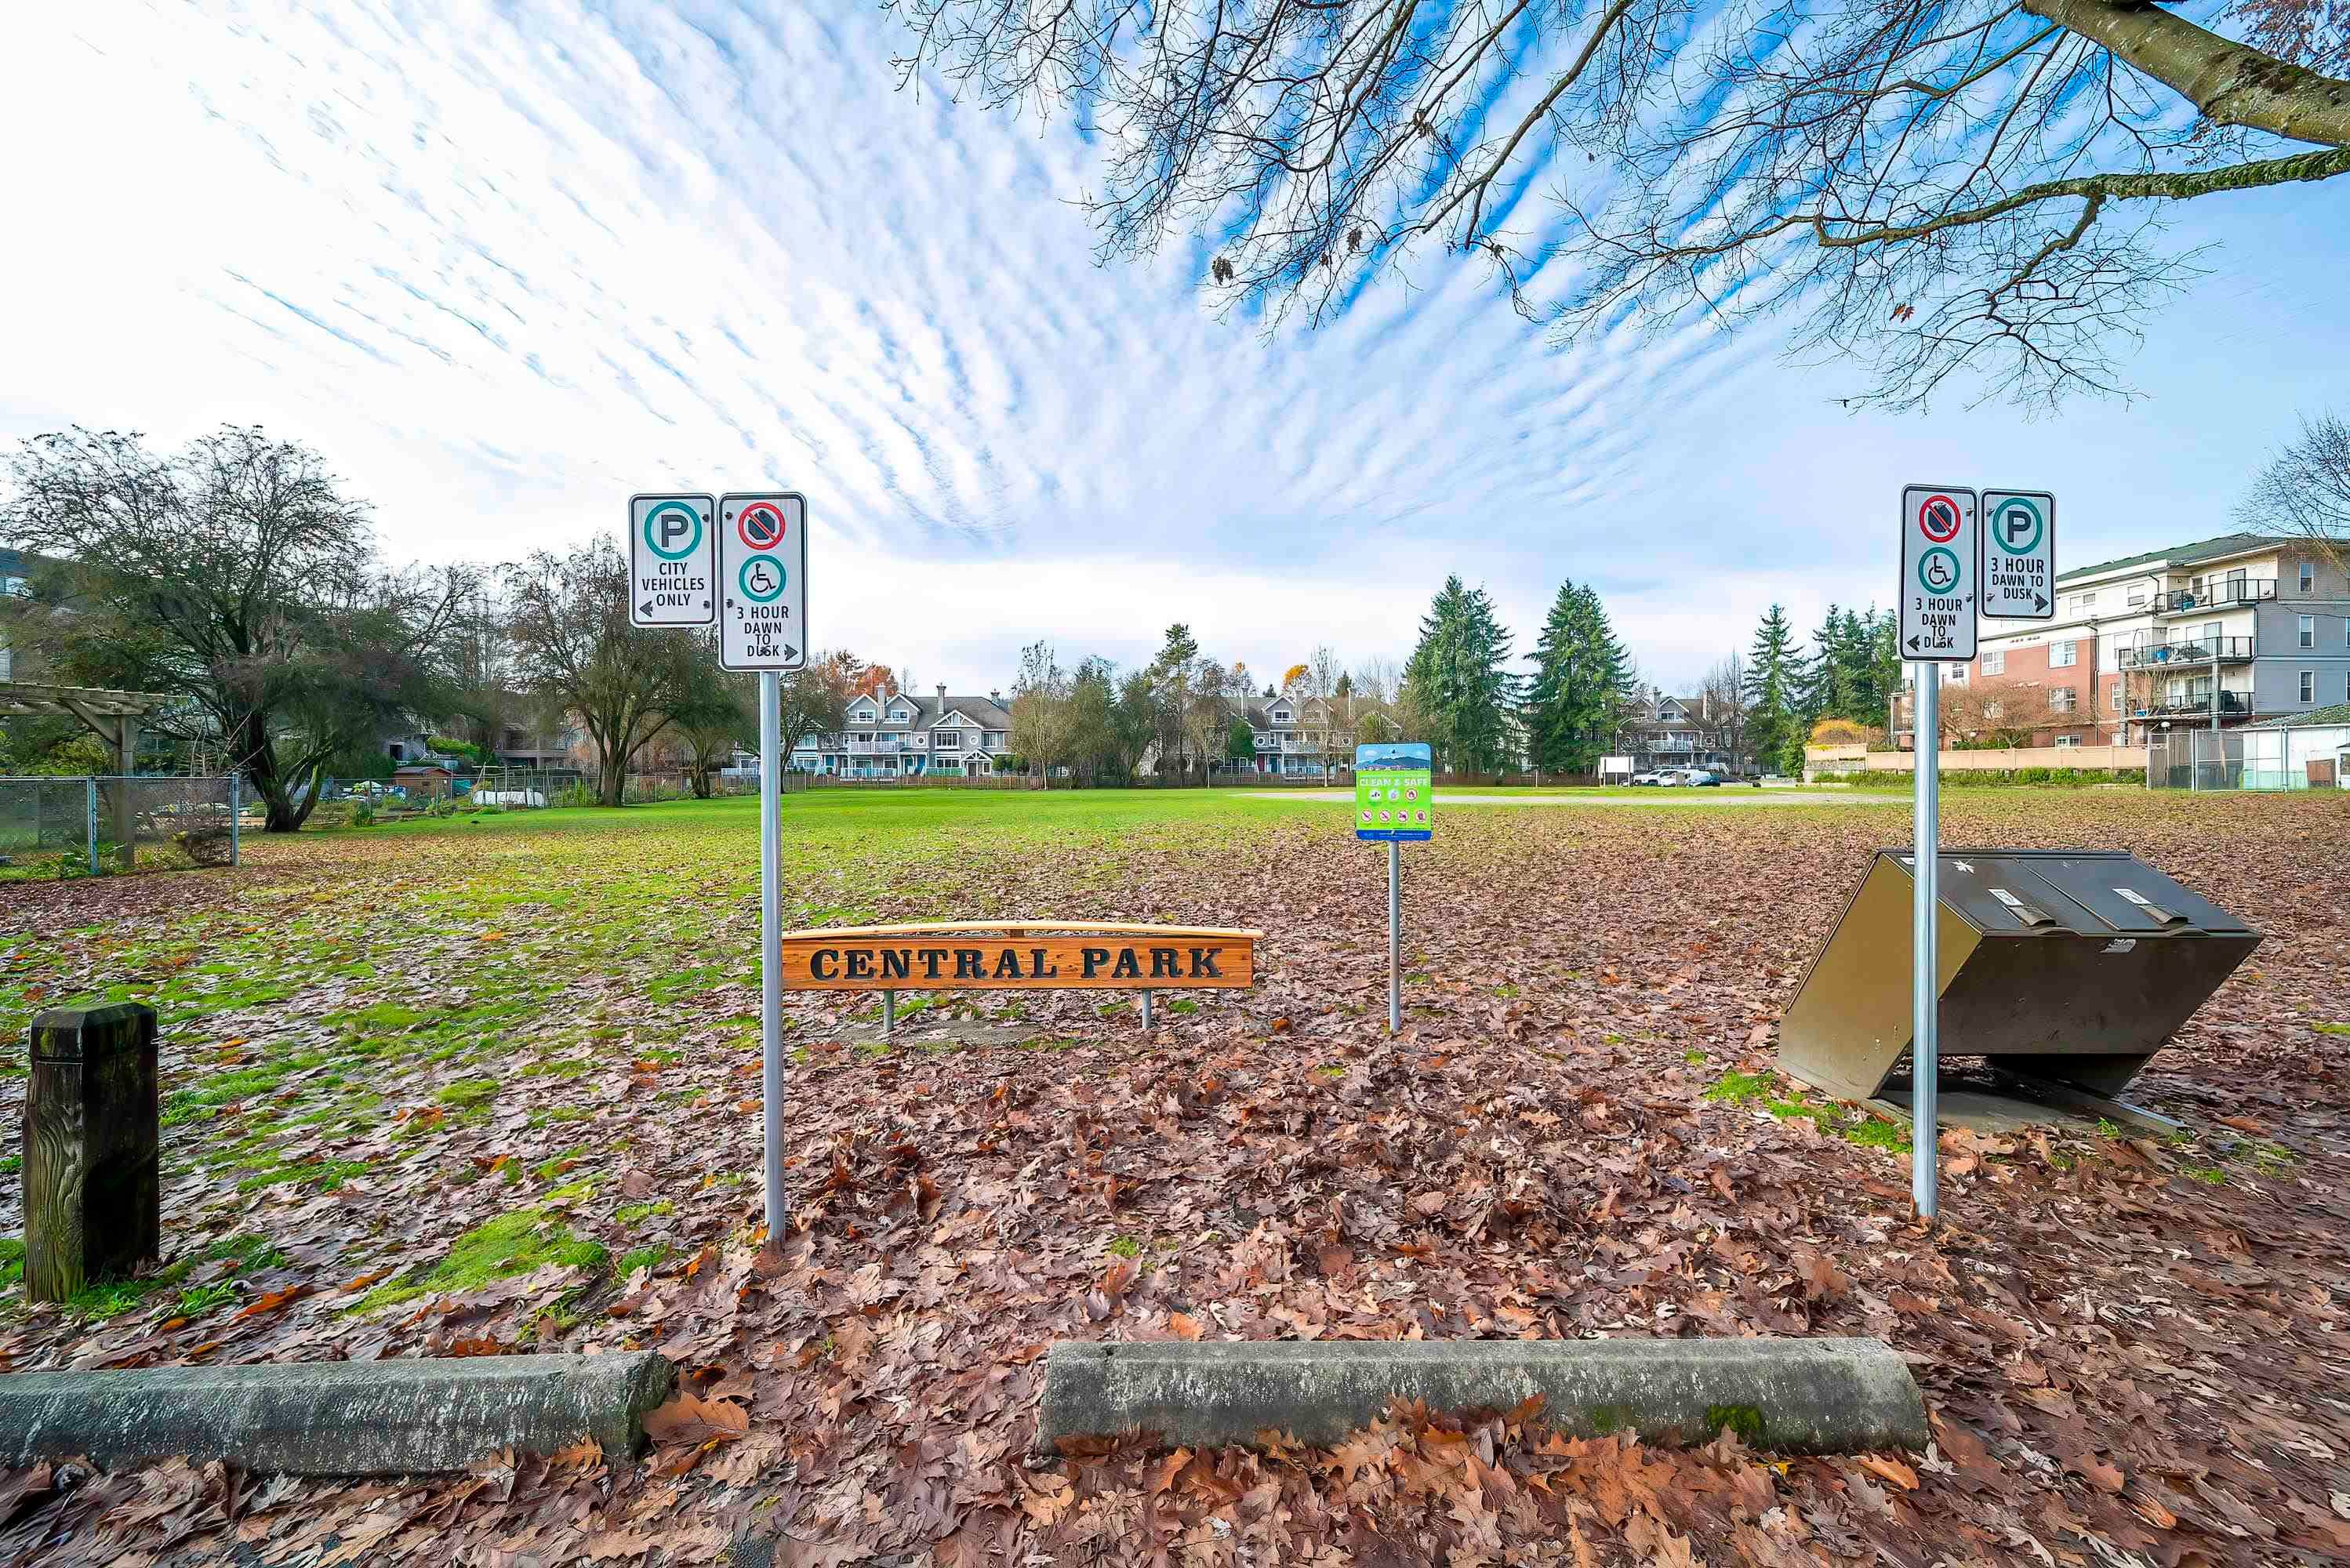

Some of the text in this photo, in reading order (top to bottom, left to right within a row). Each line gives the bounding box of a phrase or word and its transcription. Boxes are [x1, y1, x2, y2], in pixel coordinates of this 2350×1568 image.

[661, 514, 688, 547] P
[2007, 510, 2031, 543] P
[659, 562, 688, 575] CITY
[1991, 557, 2044, 573] 3 HOUR
[642, 578, 704, 591] VEHICLES
[1992, 574, 2043, 587] DAWN TO
[656, 593, 691, 606] ONLY
[2003, 588, 2032, 600] DUSK
[1916, 597, 1963, 612] 3 HOUR
[737, 606, 789, 619] 3 HOUR
[1922, 614, 1956, 626] DAWN
[745, 622, 782, 634] DAWN
[1931, 625, 1946, 637] TO
[755, 633, 771, 645] TO
[1924, 636, 1954, 648] DUSK
[747, 644, 779, 656] DUSK
[1404, 778, 1428, 786] SAFE
[810, 948, 1223, 981] CENTRAL PARK
